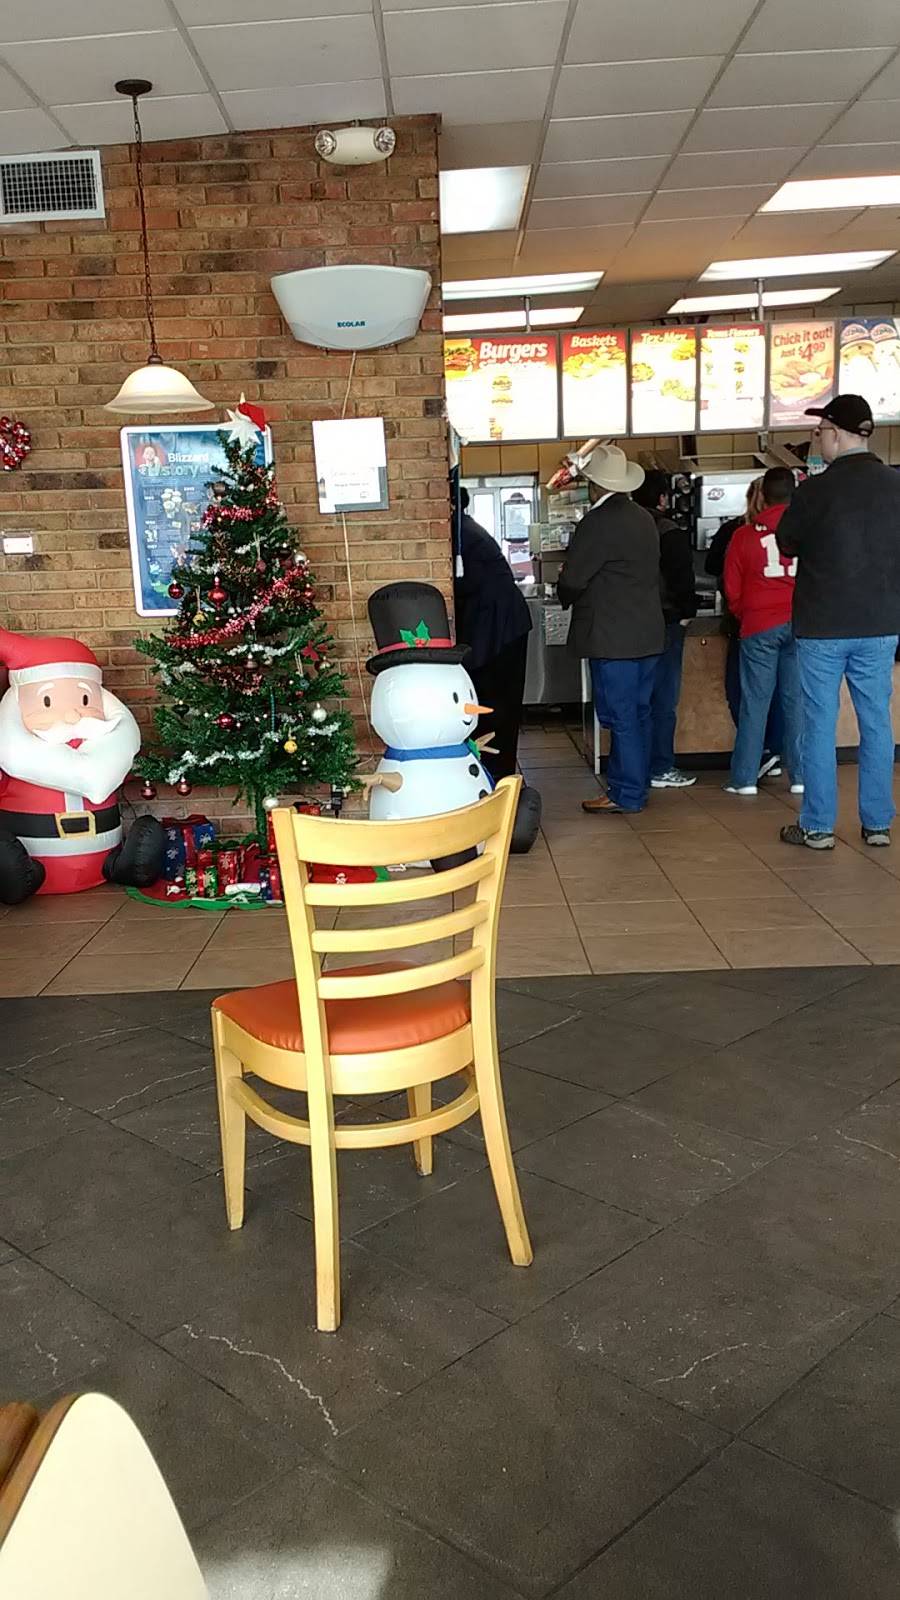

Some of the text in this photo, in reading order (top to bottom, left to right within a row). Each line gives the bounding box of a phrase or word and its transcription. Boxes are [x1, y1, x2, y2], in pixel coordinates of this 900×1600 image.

[571, 335, 617, 348] Baskets
[773, 332, 801, 347] Chick
[803, 329, 811, 342] it
[479, 342, 548, 362] Burgers
[149, 464, 199, 477] story
